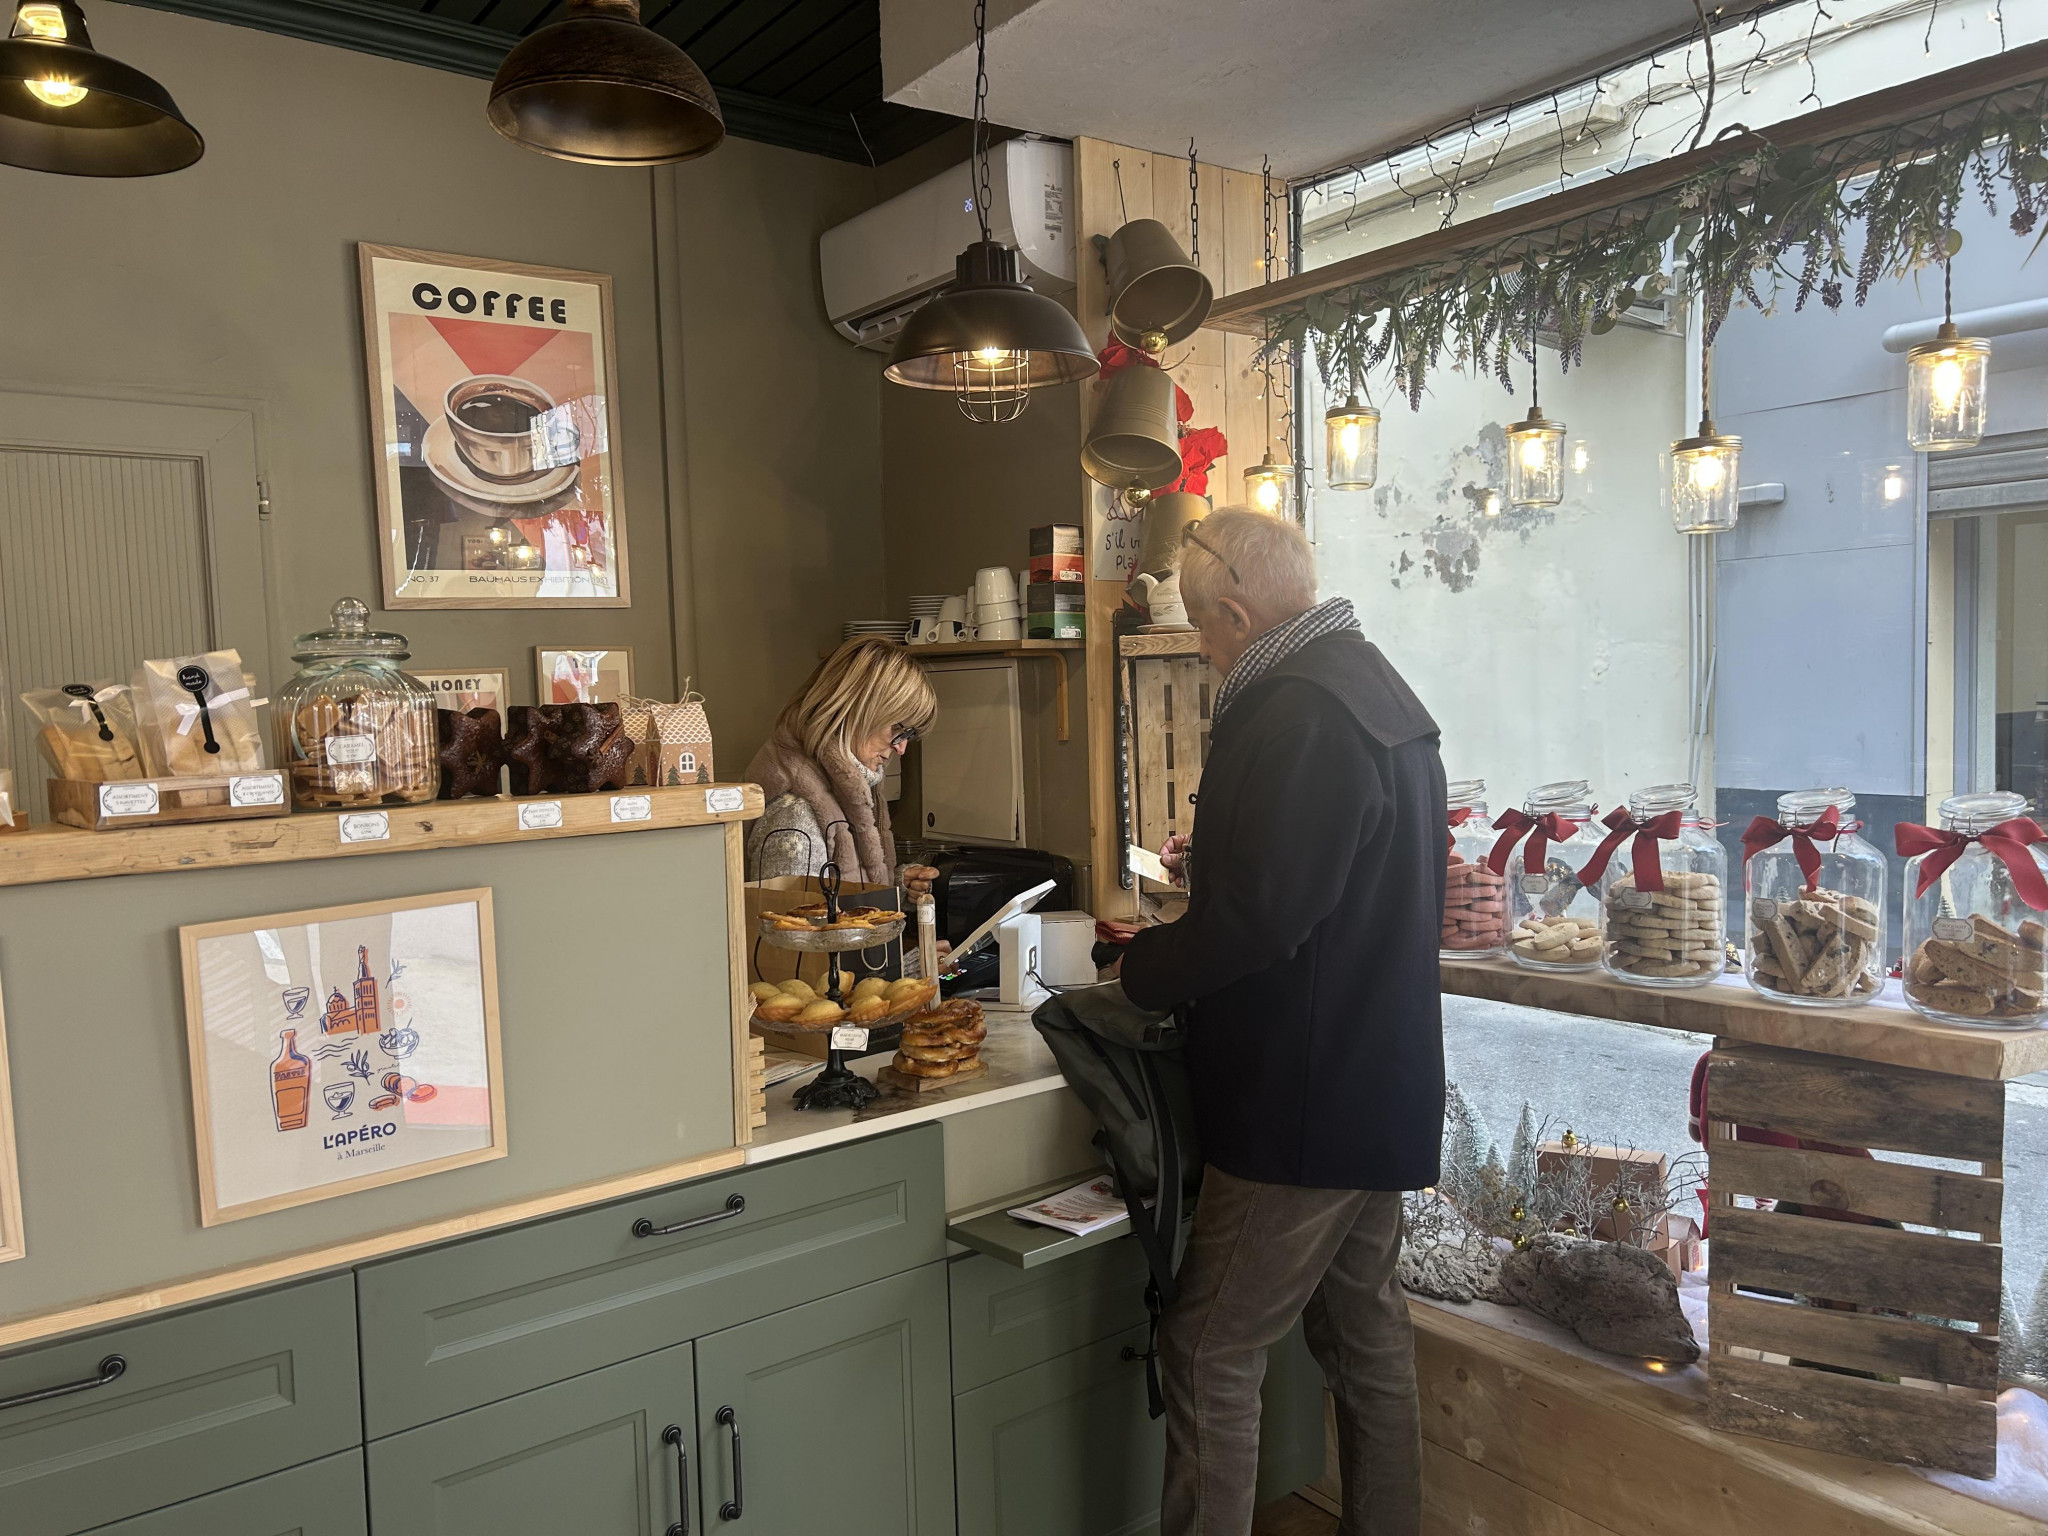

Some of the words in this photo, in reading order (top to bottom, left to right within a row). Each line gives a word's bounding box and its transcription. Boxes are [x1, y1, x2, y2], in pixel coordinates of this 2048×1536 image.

[964, 198, 973, 213] 26
[411, 282, 567, 325] COFFEE
[407, 575, 427, 584] NO.
[429, 575, 440, 584] 37
[468, 575, 528, 584] BAUHAUS
[528, 575, 590, 585] EXHIBITION
[430, 678, 482, 692] HONEY
[323, 1122, 397, 1150] L'APÉRO
[337, 1152, 343, 1160] à
[345, 1143, 386, 1160] Marseille
